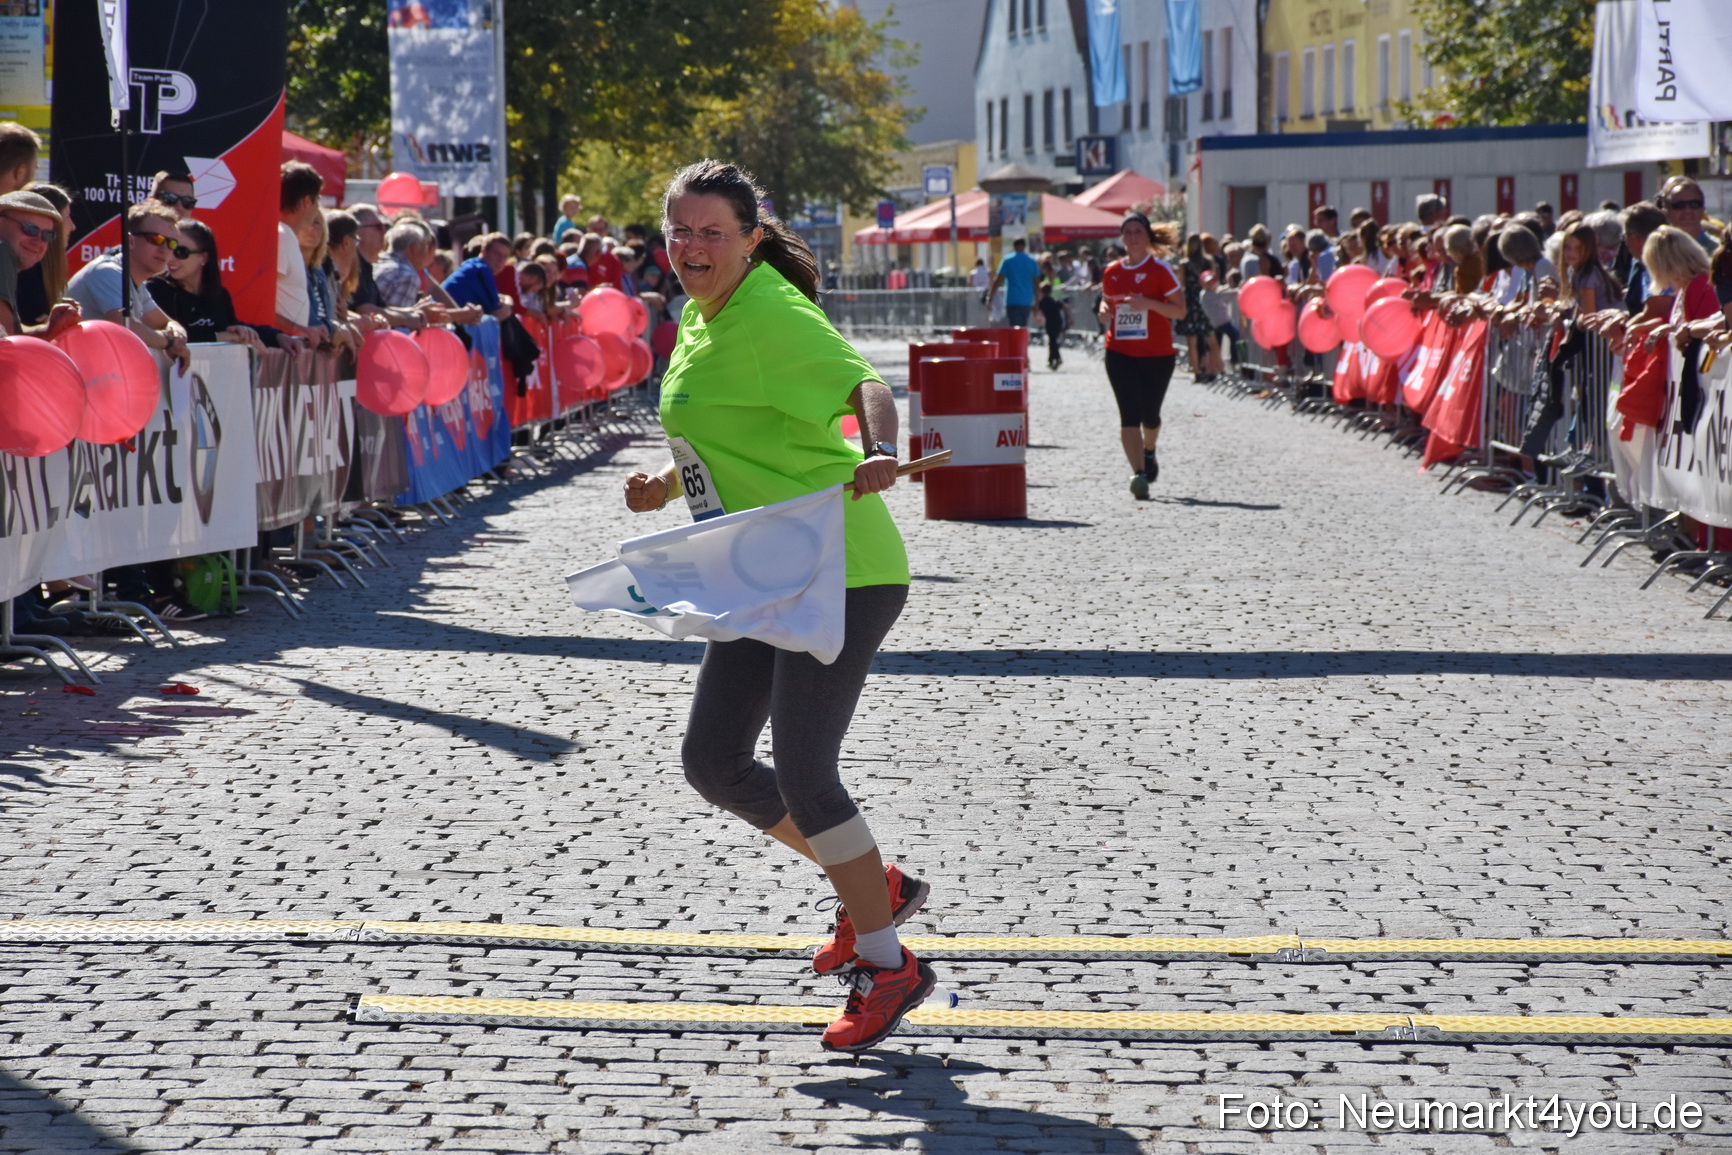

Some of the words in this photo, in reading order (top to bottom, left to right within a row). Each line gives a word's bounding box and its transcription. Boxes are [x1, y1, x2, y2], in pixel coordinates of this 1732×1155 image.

[136, 176, 155, 190] NE
[84, 187, 106, 202] 100
[1117, 313, 1142, 325] 2209
[681, 463, 706, 498] 65
